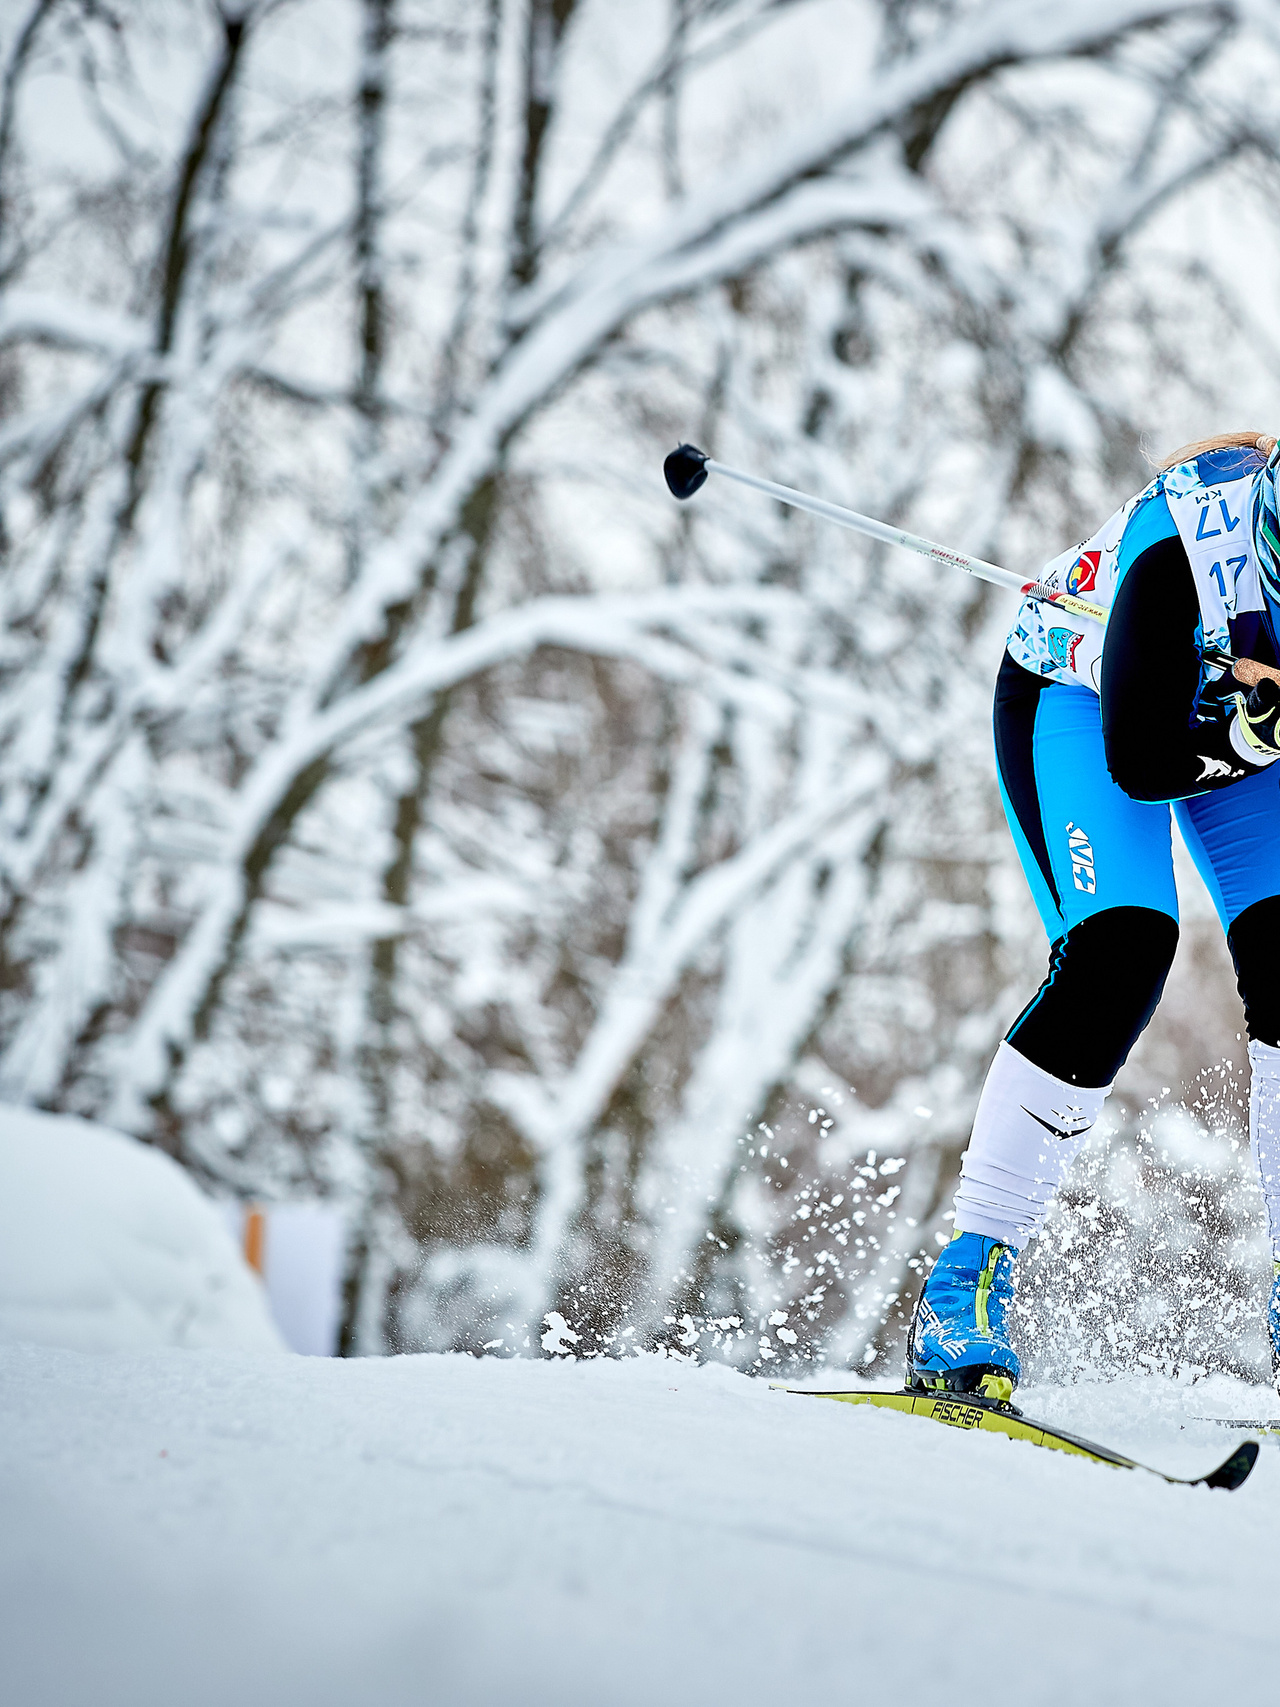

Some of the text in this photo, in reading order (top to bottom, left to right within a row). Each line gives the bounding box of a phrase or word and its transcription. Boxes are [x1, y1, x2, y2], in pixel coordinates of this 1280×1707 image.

[1196, 499, 1241, 542] 17
[1209, 554, 1247, 597] 17
[930, 1401, 984, 1429] FISCHER
